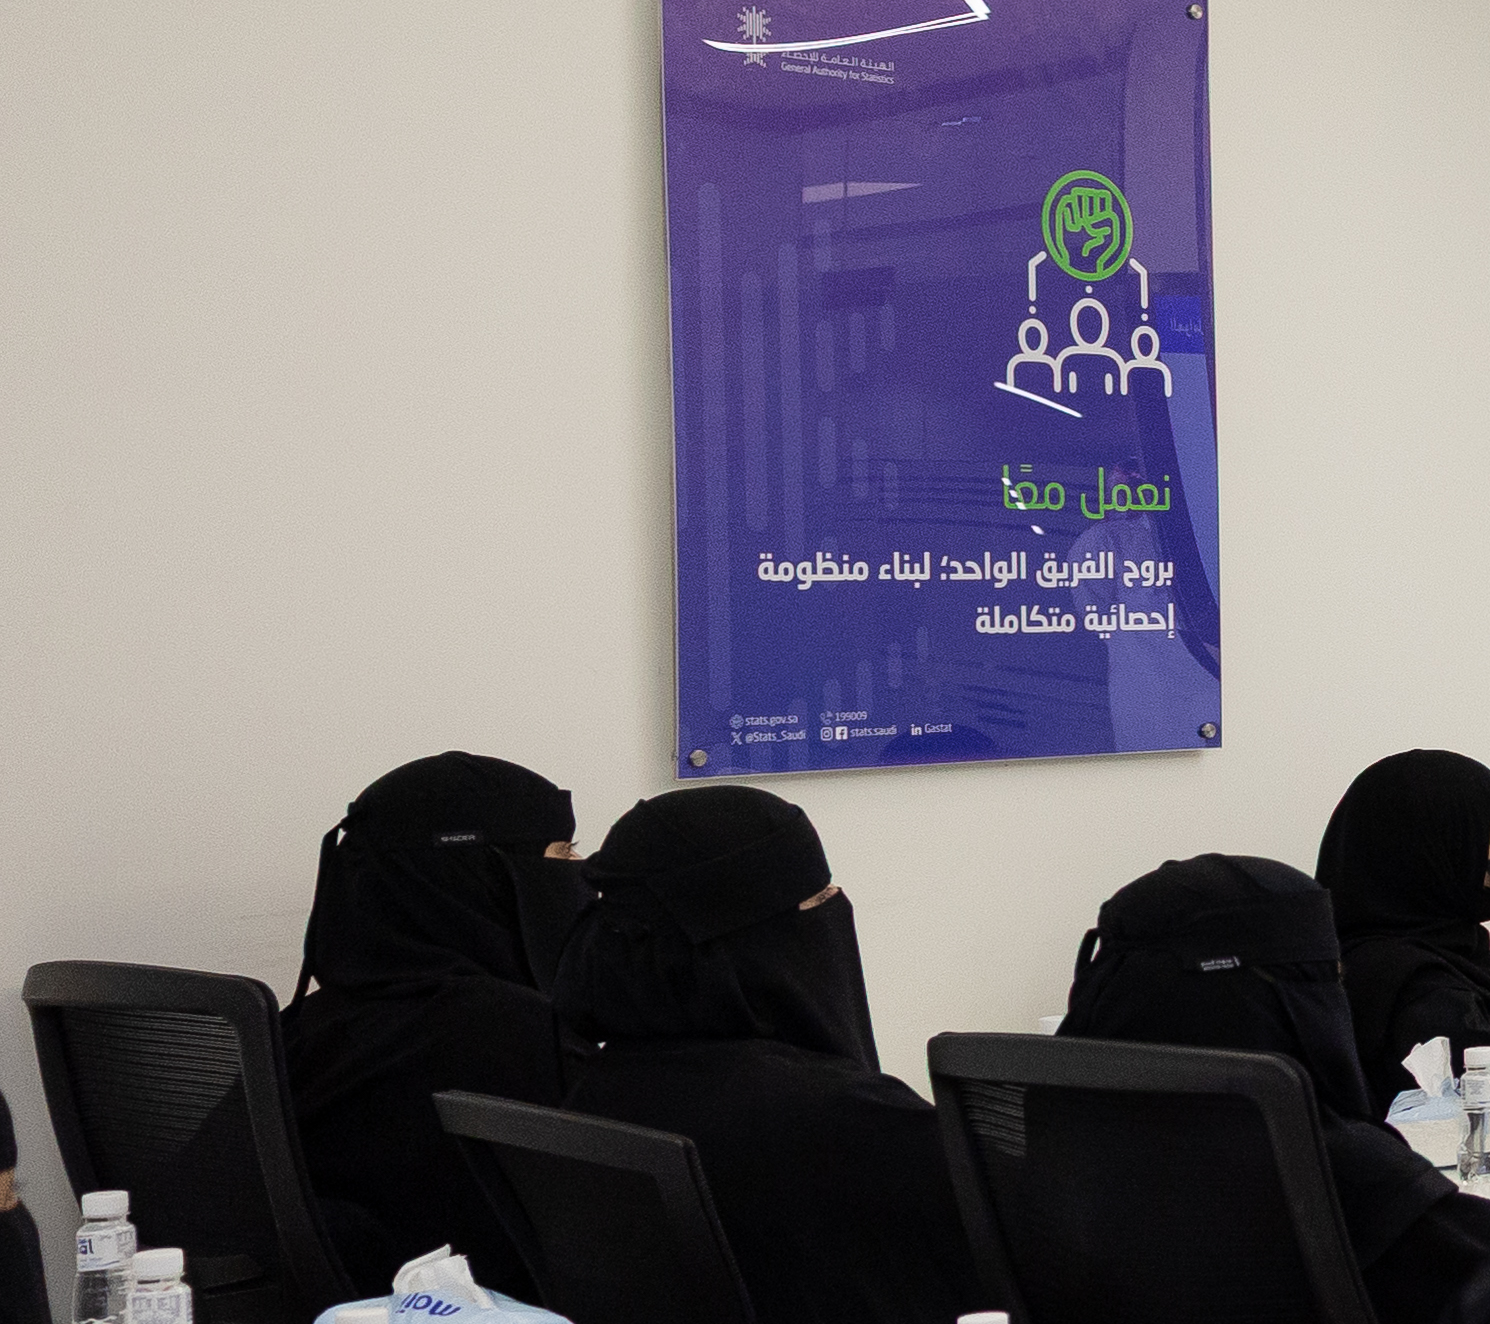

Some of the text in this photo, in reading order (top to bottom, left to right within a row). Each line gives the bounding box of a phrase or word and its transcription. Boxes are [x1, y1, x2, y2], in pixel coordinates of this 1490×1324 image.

[821, 53, 858, 67] العامة
[860, 61, 895, 72] الهيئة
[781, 62, 895, 85] General Authority for Statistics
[1080, 467, 1170, 520] نعمل
[758, 551, 1174, 590] بروح الفريق الواحد؛ لبناء منظومة
[975, 603, 1175, 639] إحصائية متكاملة
[745, 715, 799, 727] stats.gov.sa
[835, 711, 868, 722] 199009
[924, 723, 952, 734] Gastat
[745, 729, 806, 743] @Stats_Saudi
